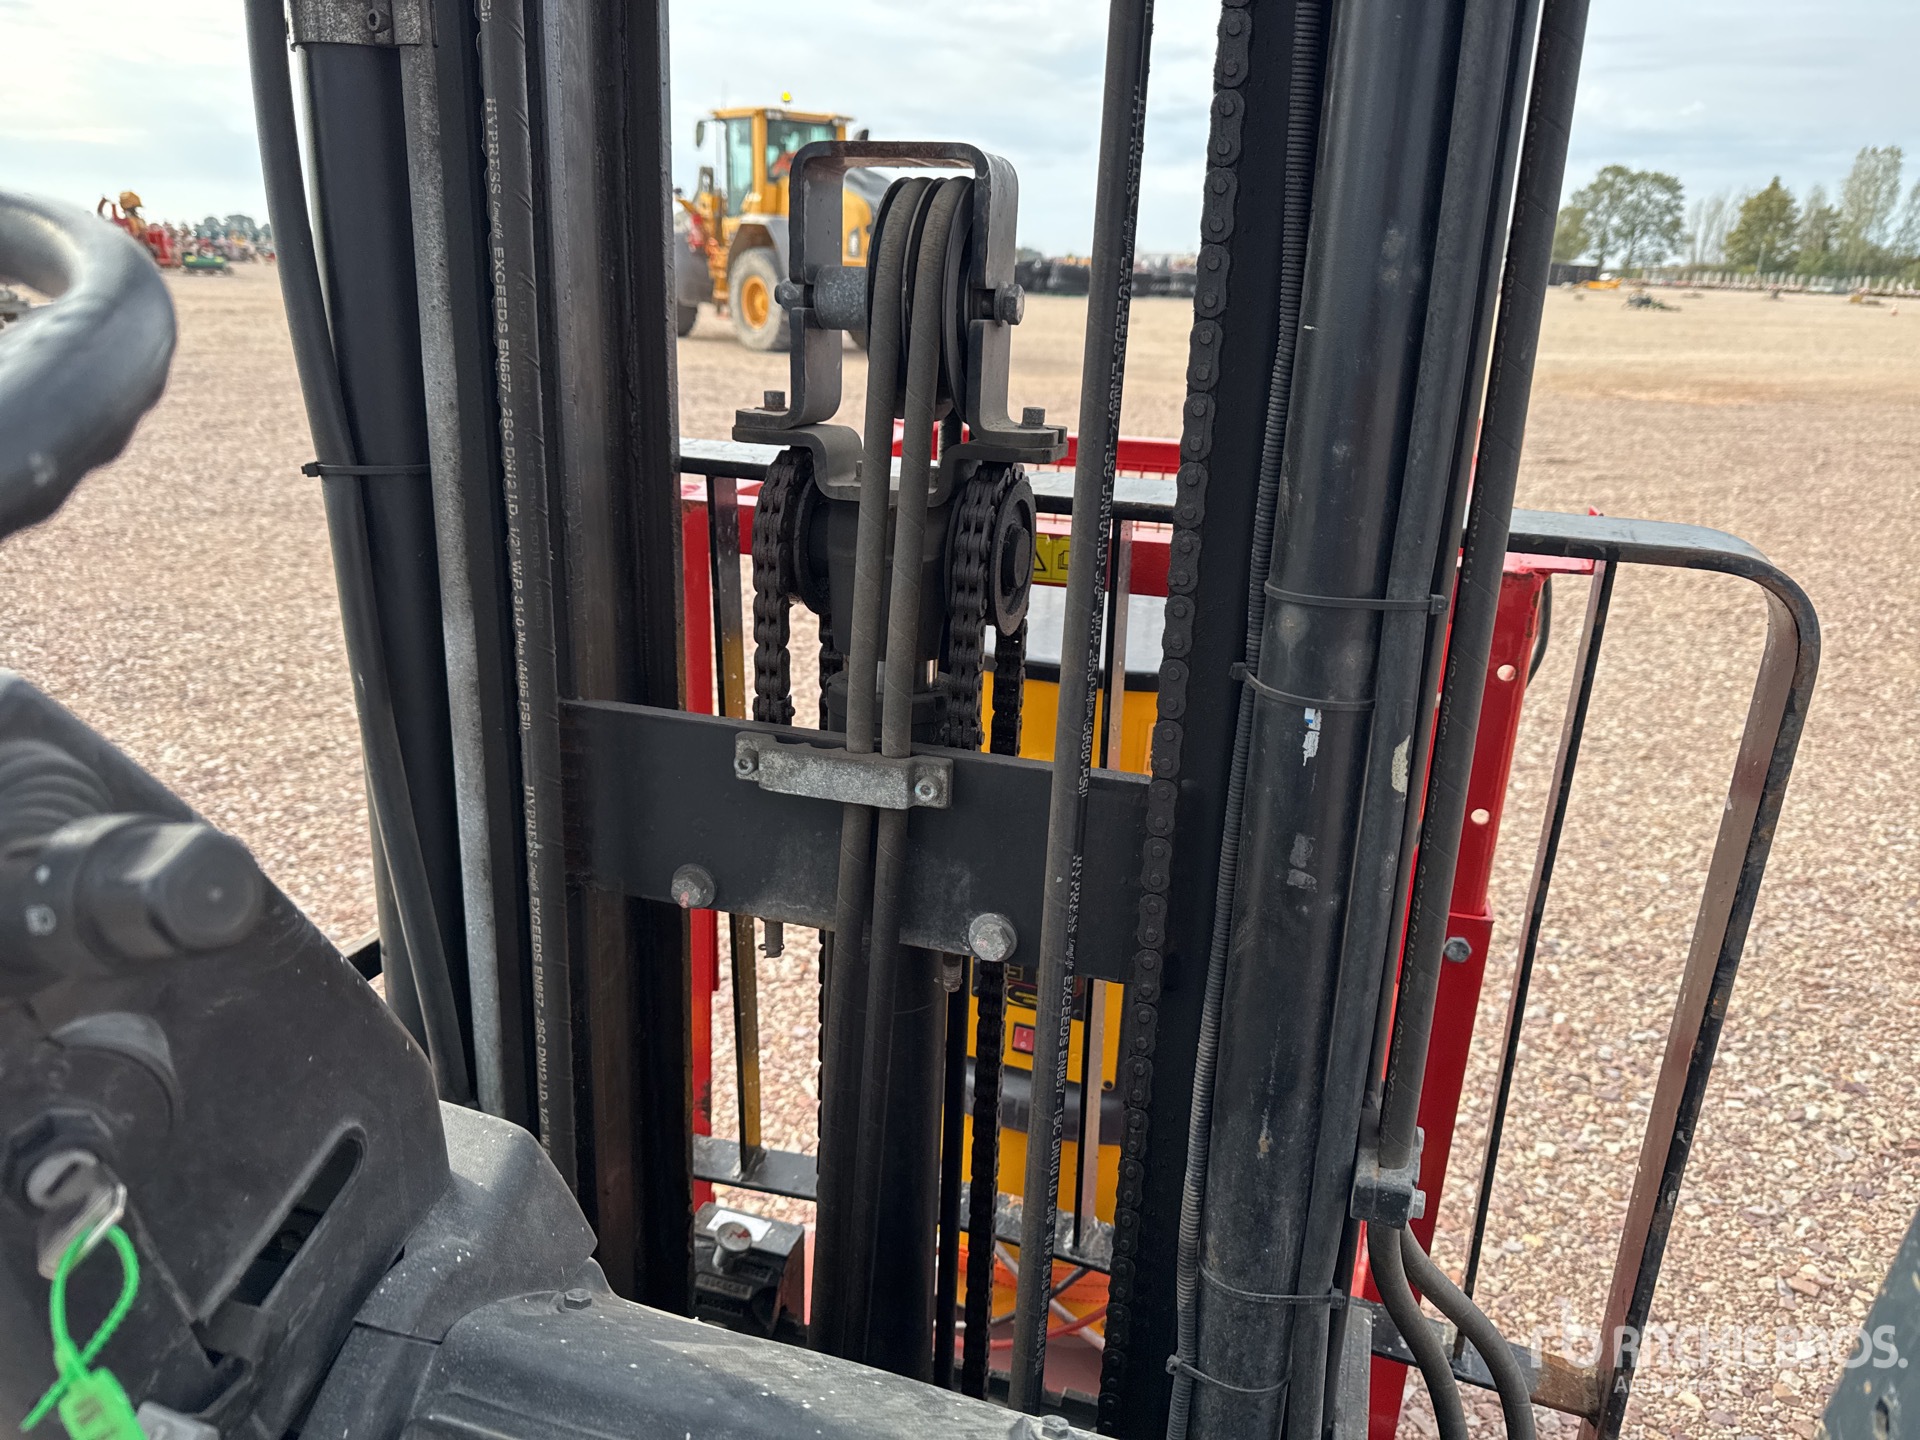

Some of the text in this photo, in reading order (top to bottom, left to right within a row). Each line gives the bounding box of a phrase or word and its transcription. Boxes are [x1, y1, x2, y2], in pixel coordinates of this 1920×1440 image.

[486, 97, 500, 194] HYPRESS
[491, 200, 503, 239] LongLife
[494, 246, 508, 333] EXCEEDS
[1112, 257, 1132, 365] EXCEEDS
[525, 785, 537, 858] HYPRESS
[1067, 855, 1082, 933] HYPRESS
[530, 895, 542, 961] EXCEEDS
[533, 965, 544, 1006] EN857
[1058, 974, 1073, 1047] EXCEEDS
[536, 1016, 545, 1045] 2SC
[537, 1046, 547, 1080] DN12
[1055, 1050, 1067, 1093] EN857
[1052, 1106, 1062, 1136] 1SC
